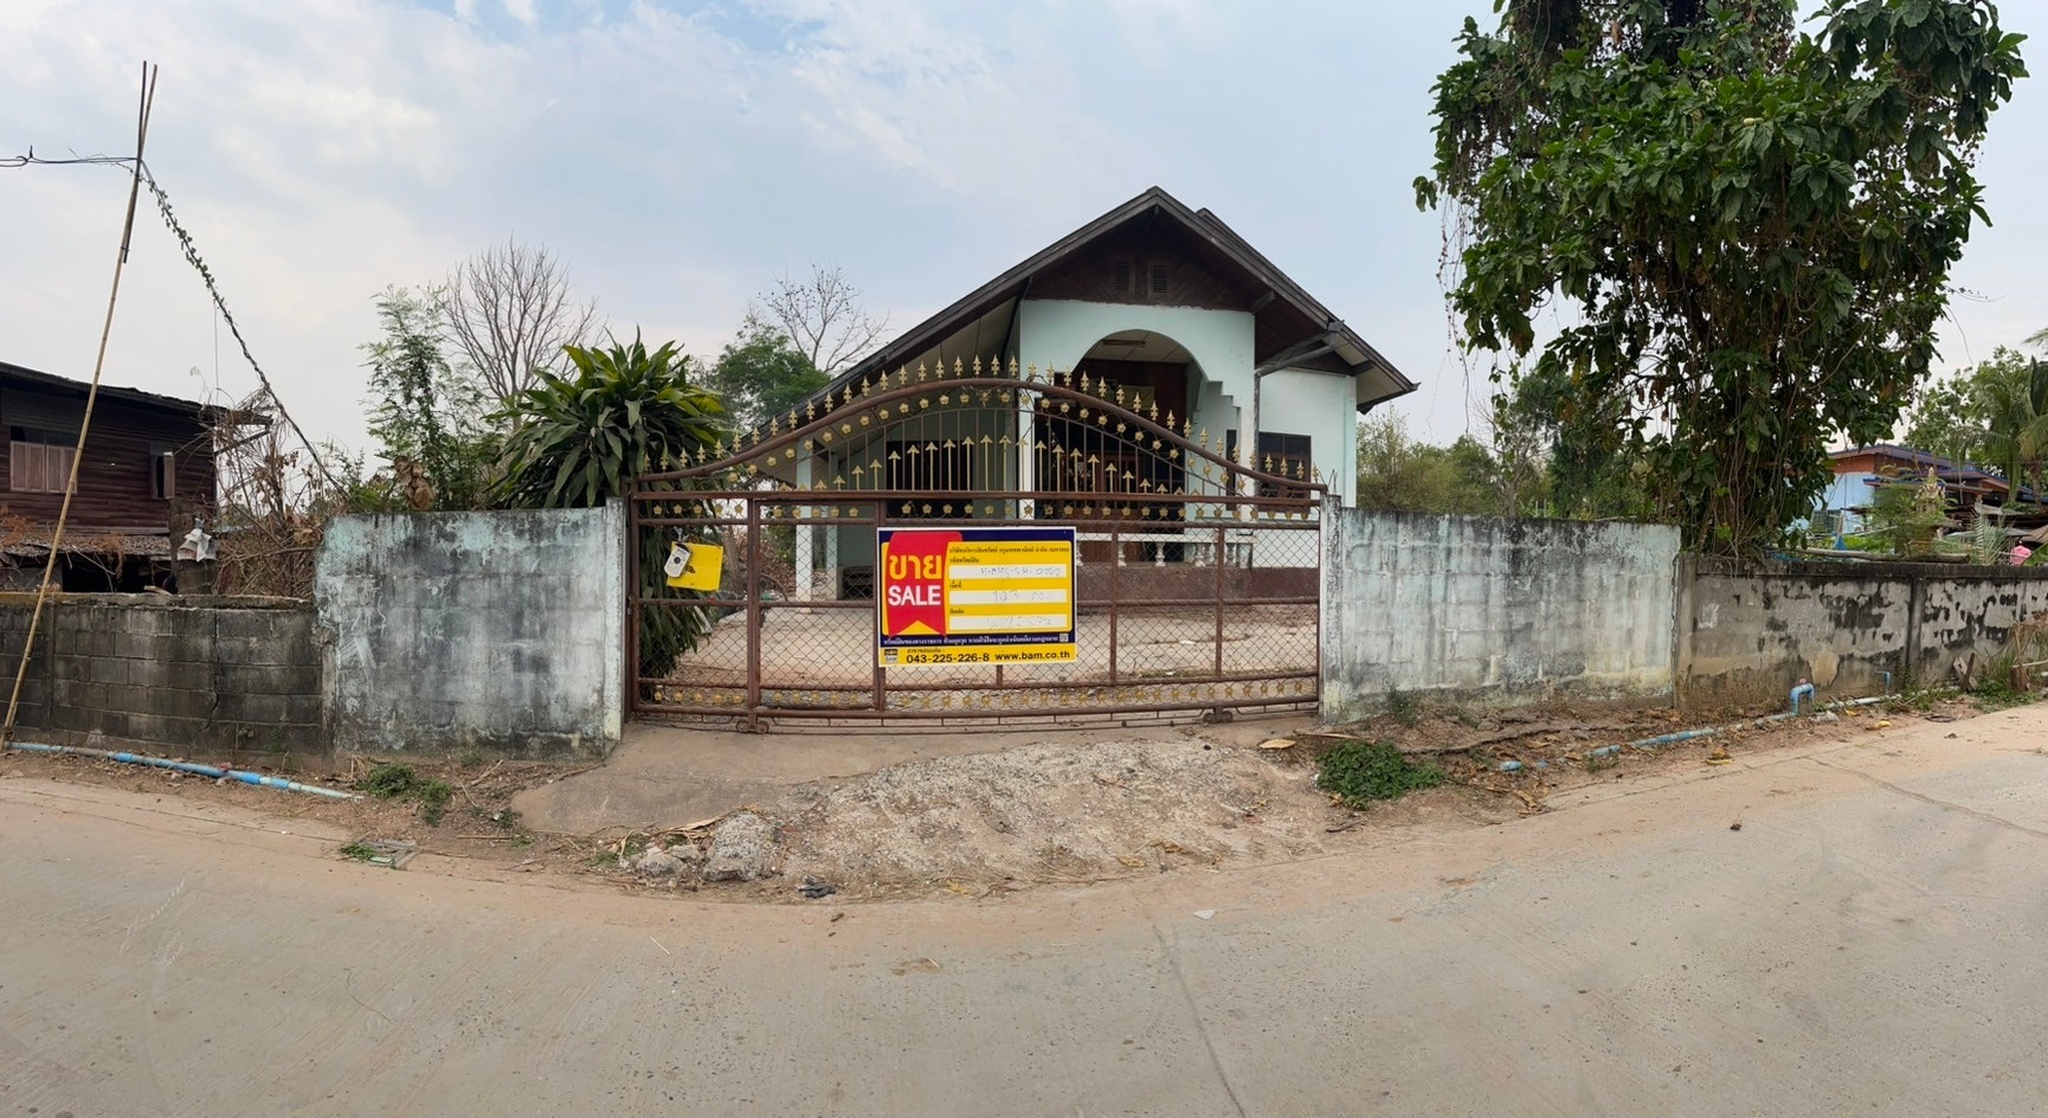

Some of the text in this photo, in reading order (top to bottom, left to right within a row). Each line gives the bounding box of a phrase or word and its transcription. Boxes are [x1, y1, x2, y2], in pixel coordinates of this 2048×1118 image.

[889, 554, 942, 580] ขาย
[888, 585, 941, 607] SALE
[906, 653, 990, 664] 043-225-226-8
[995, 651, 1071, 661] www.bam.co.th
